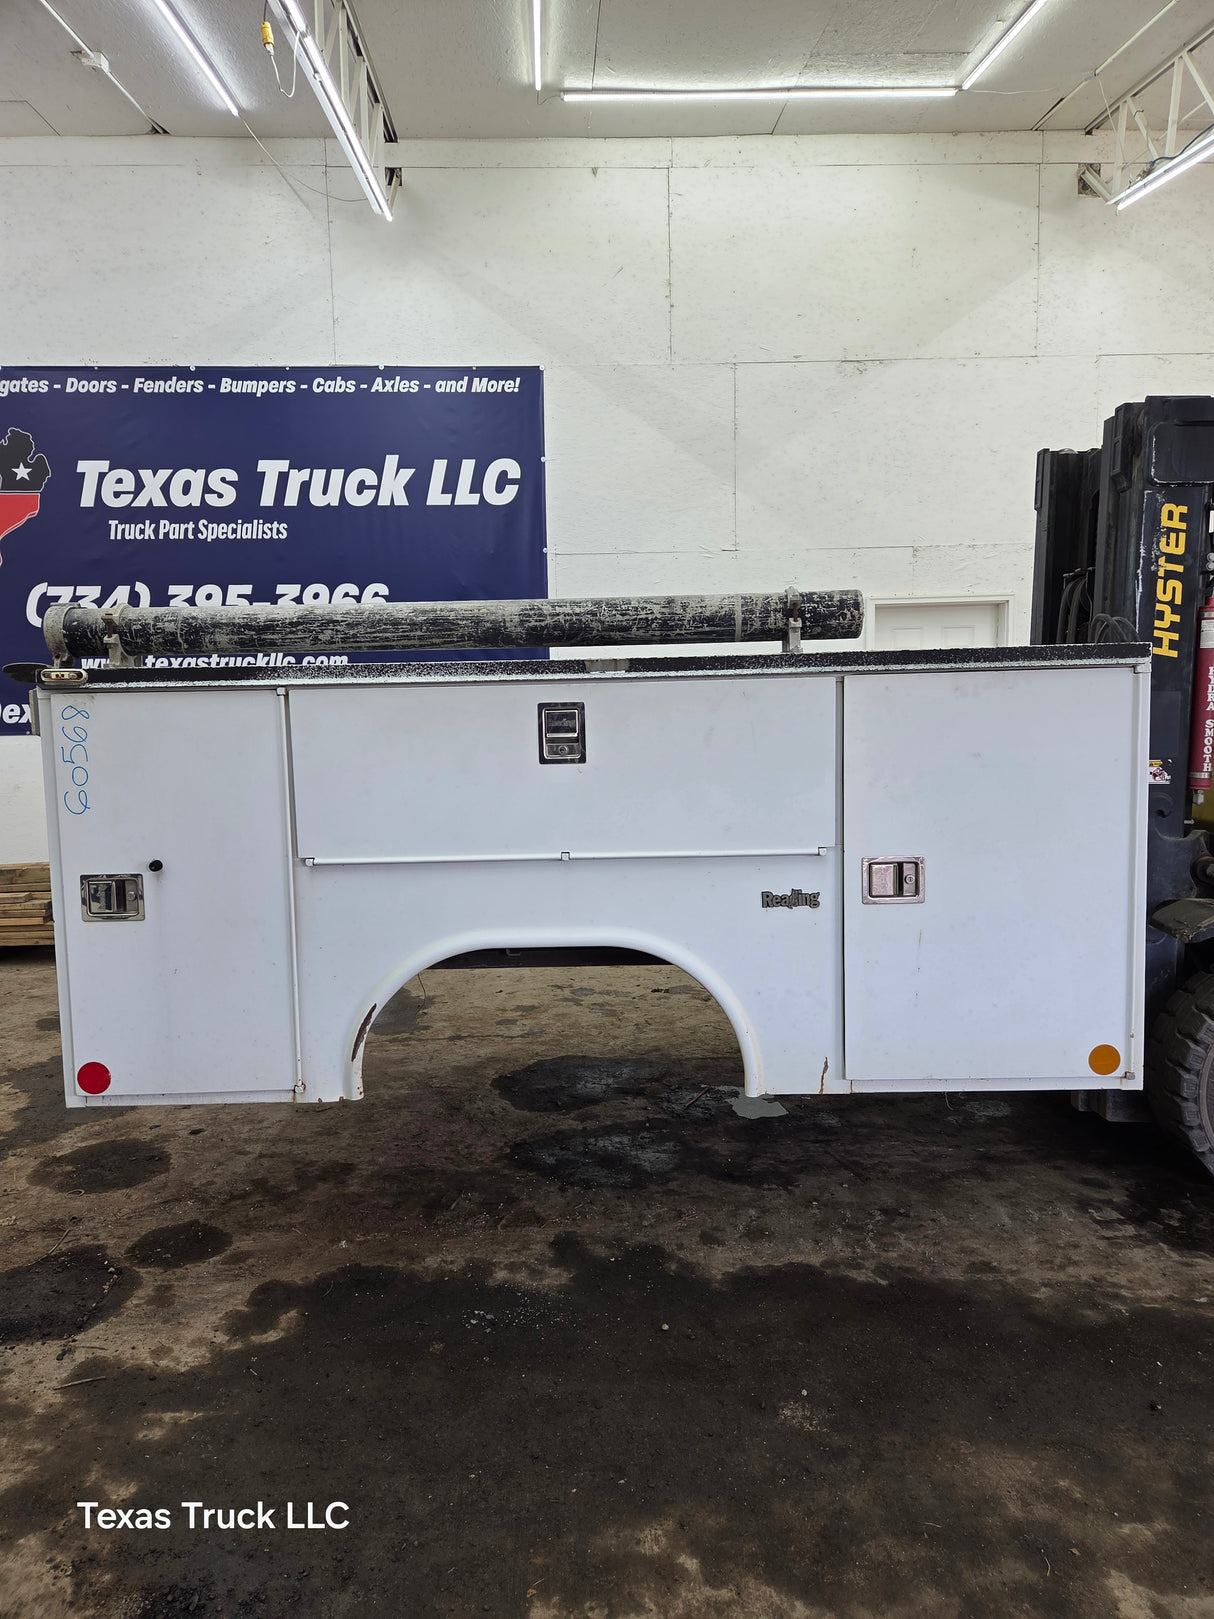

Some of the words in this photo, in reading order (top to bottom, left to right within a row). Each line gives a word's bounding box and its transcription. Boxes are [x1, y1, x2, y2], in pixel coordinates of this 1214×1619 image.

[65, 377, 117, 393] Doors
[133, 376, 204, 393] Fenders
[219, 377, 297, 397] Bumpers
[312, 376, 356, 393] Cabs
[371, 376, 420, 393] Axles
[435, 376, 468, 393] and
[471, 377, 521, 393] More!
[76, 460, 239, 507] Texas
[256, 454, 416, 507] Truck
[426, 458, 522, 506] LLC
[108, 520, 156, 540] Truck
[158, 520, 195, 540] Part
[197, 519, 288, 542] Specialists
[1152, 503, 1188, 658] HYSTER
[61, 705, 91, 815] 60568
[1203, 719, 1214, 773] SMOOTH
[761, 889, 820, 909] Reading
